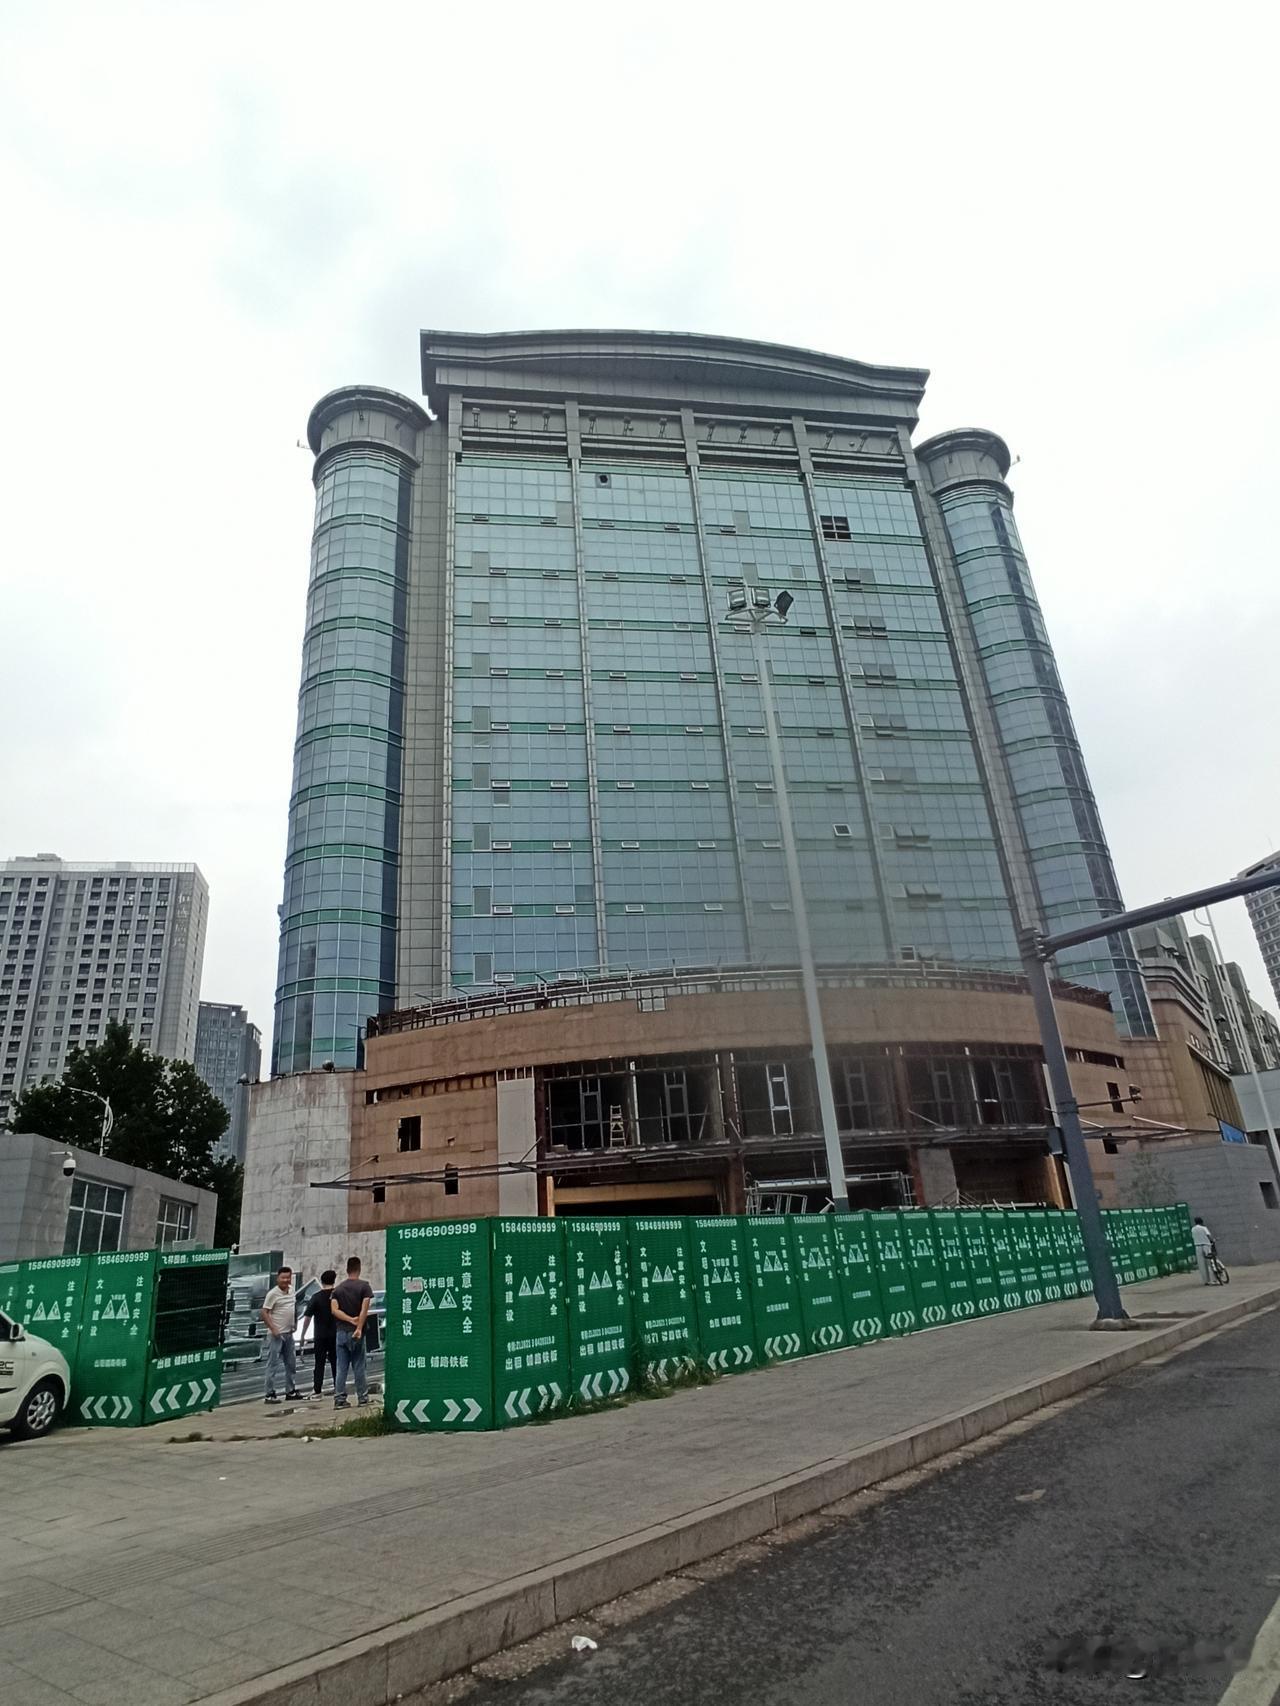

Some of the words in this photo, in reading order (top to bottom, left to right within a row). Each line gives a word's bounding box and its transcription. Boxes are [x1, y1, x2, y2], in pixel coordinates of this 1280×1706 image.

[398, 1222, 476, 1239] 15846909999
[501, 1222, 556, 1232] 15846909999
[572, 1222, 620, 1232] 15846909999
[28, 1257, 81, 1270] 15846909999
[97, 1252, 149, 1264] 15846909999
[505, 1254, 514, 1321] 文明建设
[548, 1254, 557, 1316] 注意安全
[577, 1251, 586, 1312] 文明建设
[462, 1250, 472, 1333] 注意安全
[408, 1357, 425, 1368] 出租
[505, 1357, 522, 1370] 出租
